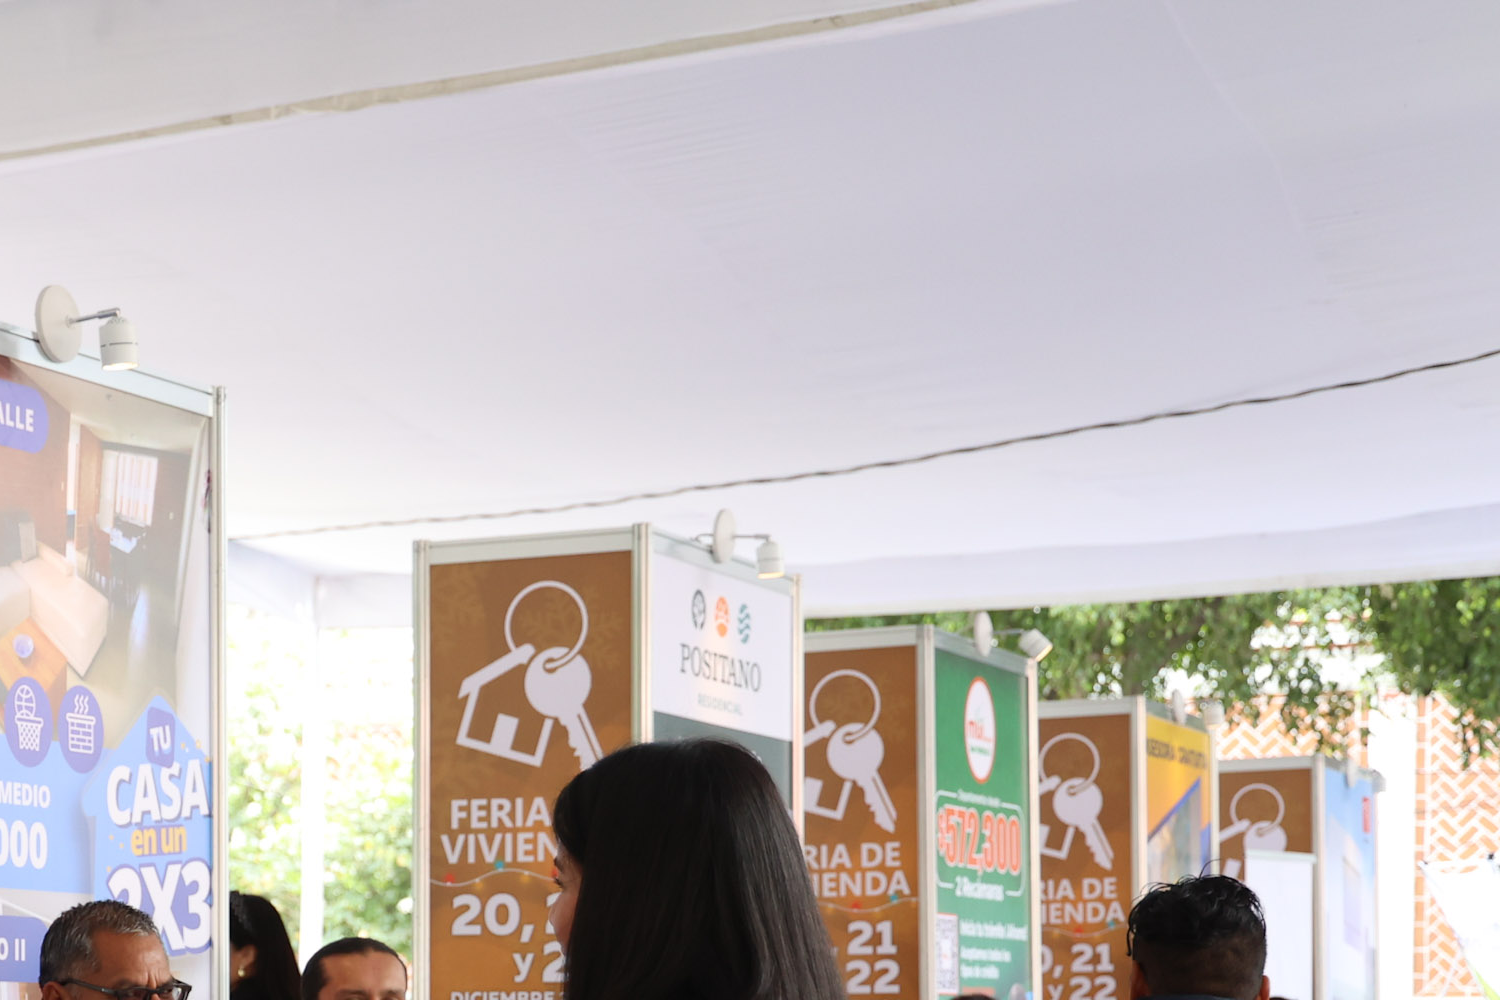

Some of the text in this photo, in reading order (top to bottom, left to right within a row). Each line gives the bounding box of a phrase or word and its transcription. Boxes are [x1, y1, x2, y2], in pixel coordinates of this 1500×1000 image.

[680, 643, 762, 692] POSITANO
[149, 725, 171, 753] TU
[107, 759, 209, 827] CASA
[450, 797, 552, 830] FERIA
[131, 825, 187, 856] en un
[860, 842, 901, 868] DE
[1082, 877, 1117, 899] DE
[451, 893, 534, 943] 20,
[15, 939, 26, 962] II
[847, 920, 897, 956] 21
[512, 953, 534, 982] y
[1071, 943, 1114, 973] 21
[845, 959, 900, 994] 22
